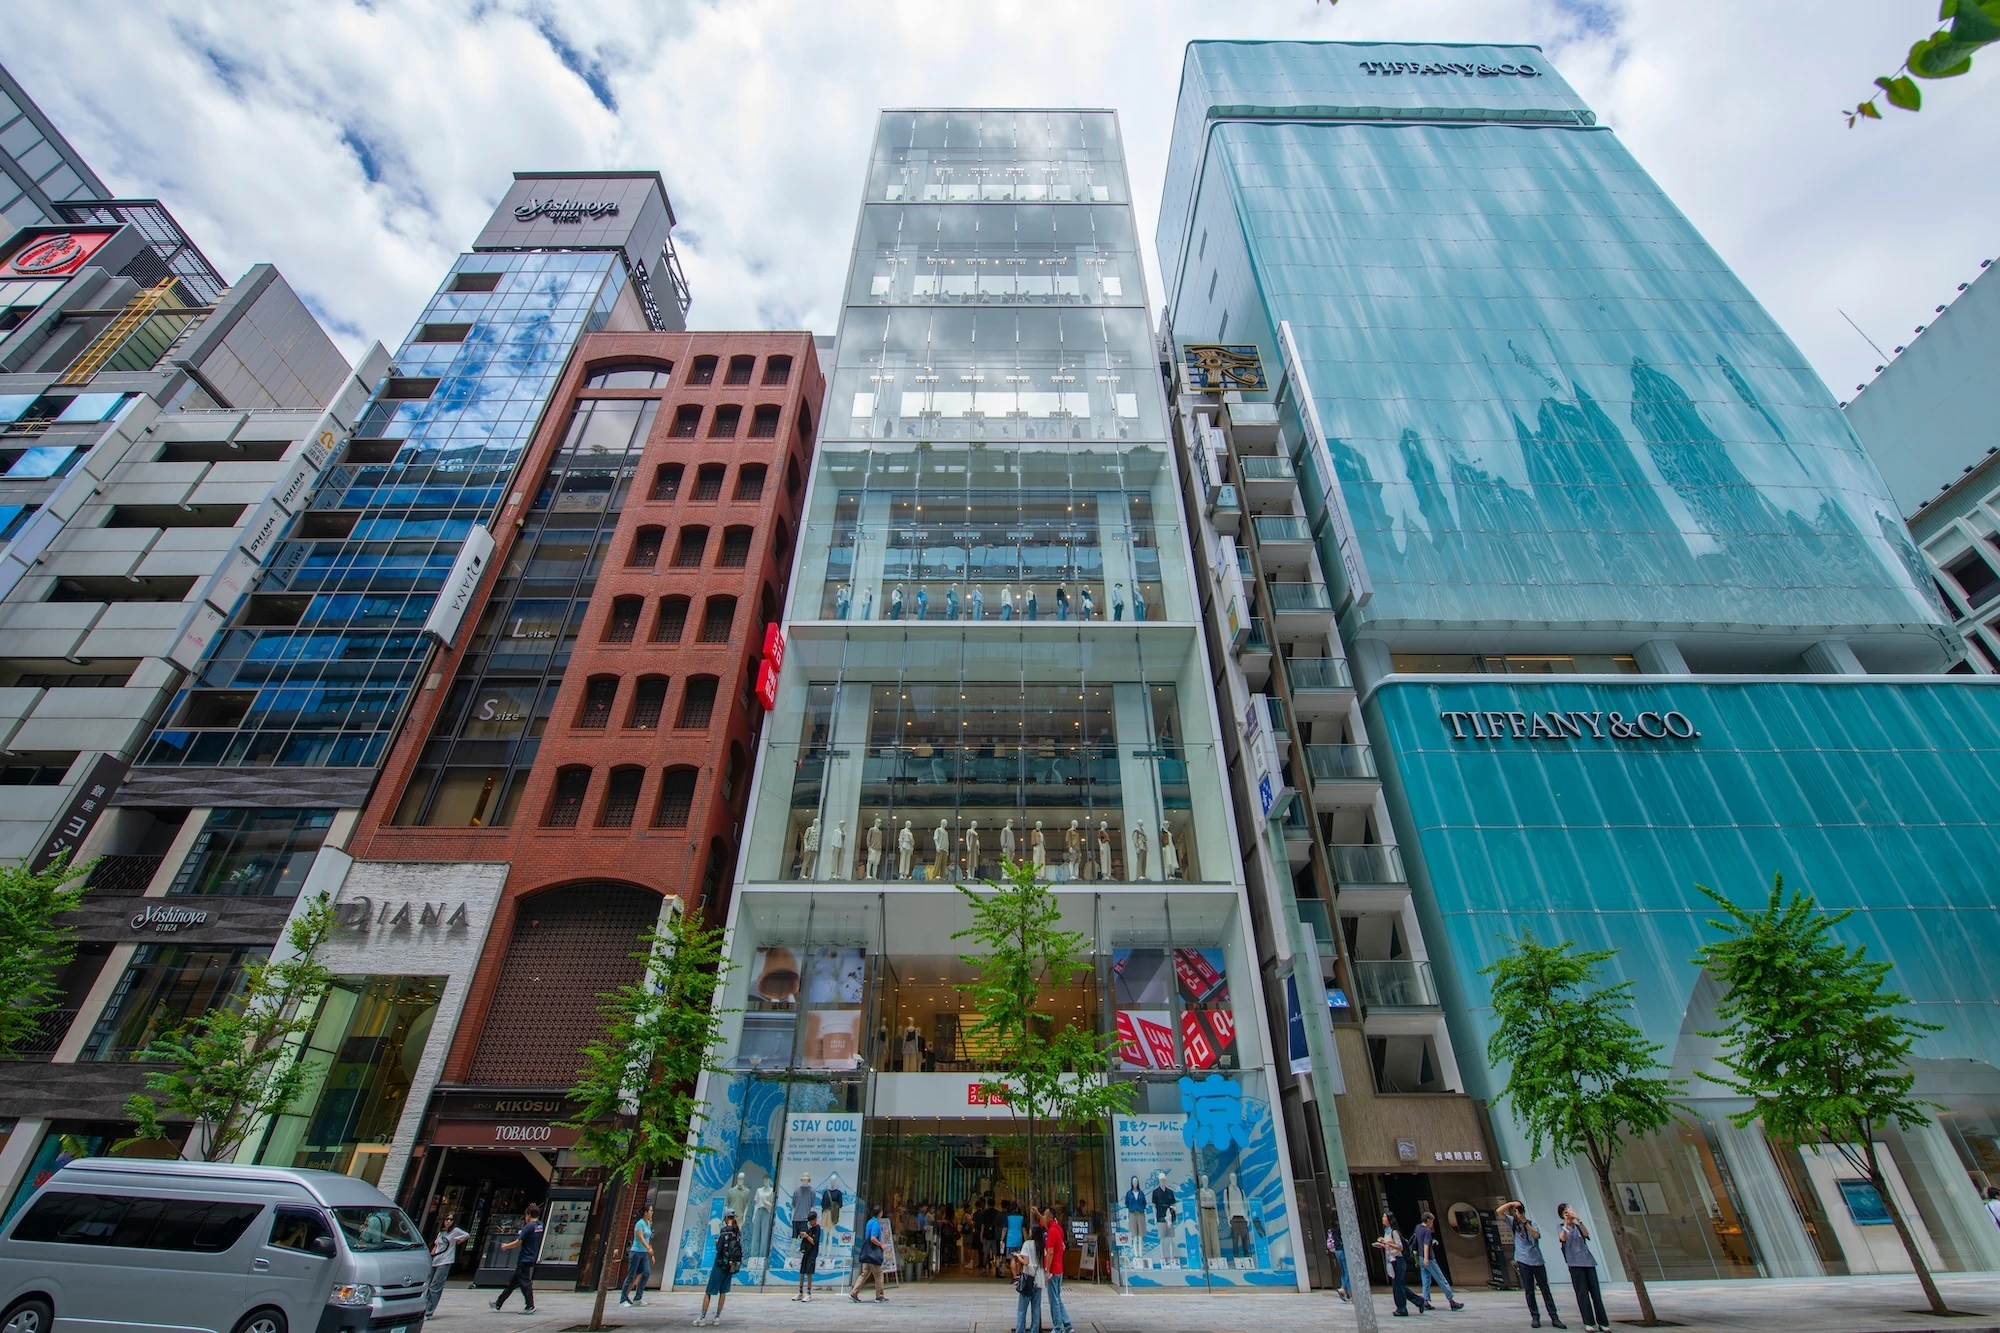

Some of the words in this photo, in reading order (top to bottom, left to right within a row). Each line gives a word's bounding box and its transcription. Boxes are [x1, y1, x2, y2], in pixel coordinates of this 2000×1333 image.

[513, 198, 618, 221] Yoshinoya
[548, 210, 580, 218] GINZA
[282, 471, 305, 504] SHIMA
[250, 517, 275, 553] SHIMA
[451, 555, 482, 611] DIANA
[207, 611, 217, 621] 4F
[512, 618, 526, 638] L
[527, 628, 551, 638] size
[479, 698, 499, 721] S
[495, 711, 520, 721] size
[130, 905, 208, 930] Yoshinoya
[335, 895, 470, 928] DIANA
[155, 923, 178, 932] GINZA
[494, 1125, 551, 1141] TOBACCO
[792, 1119, 821, 1132] STAY
[826, 1119, 857, 1132] COOL
[1118, 1120, 1183, 1132] 夏をクールに、
[1119, 1135, 1152, 1147] 楽しく。
